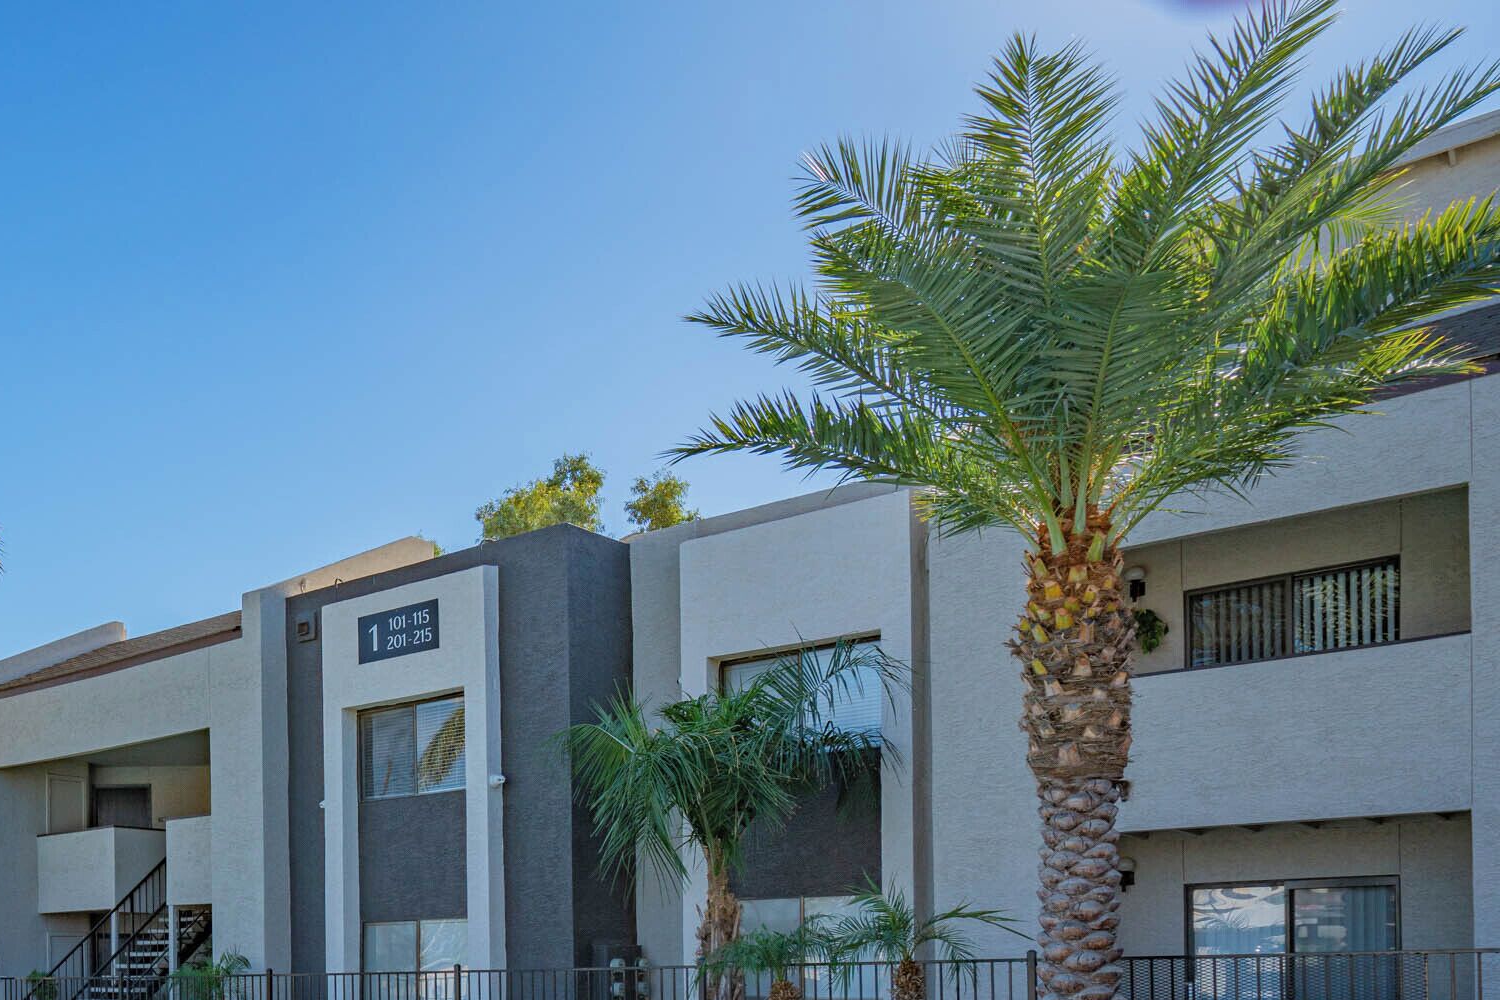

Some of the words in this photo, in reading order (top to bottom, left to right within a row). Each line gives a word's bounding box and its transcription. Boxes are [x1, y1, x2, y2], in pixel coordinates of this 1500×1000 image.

[388, 608, 430, 631] 101-115
[368, 623, 379, 652] 1
[387, 627, 432, 650] 201-215
